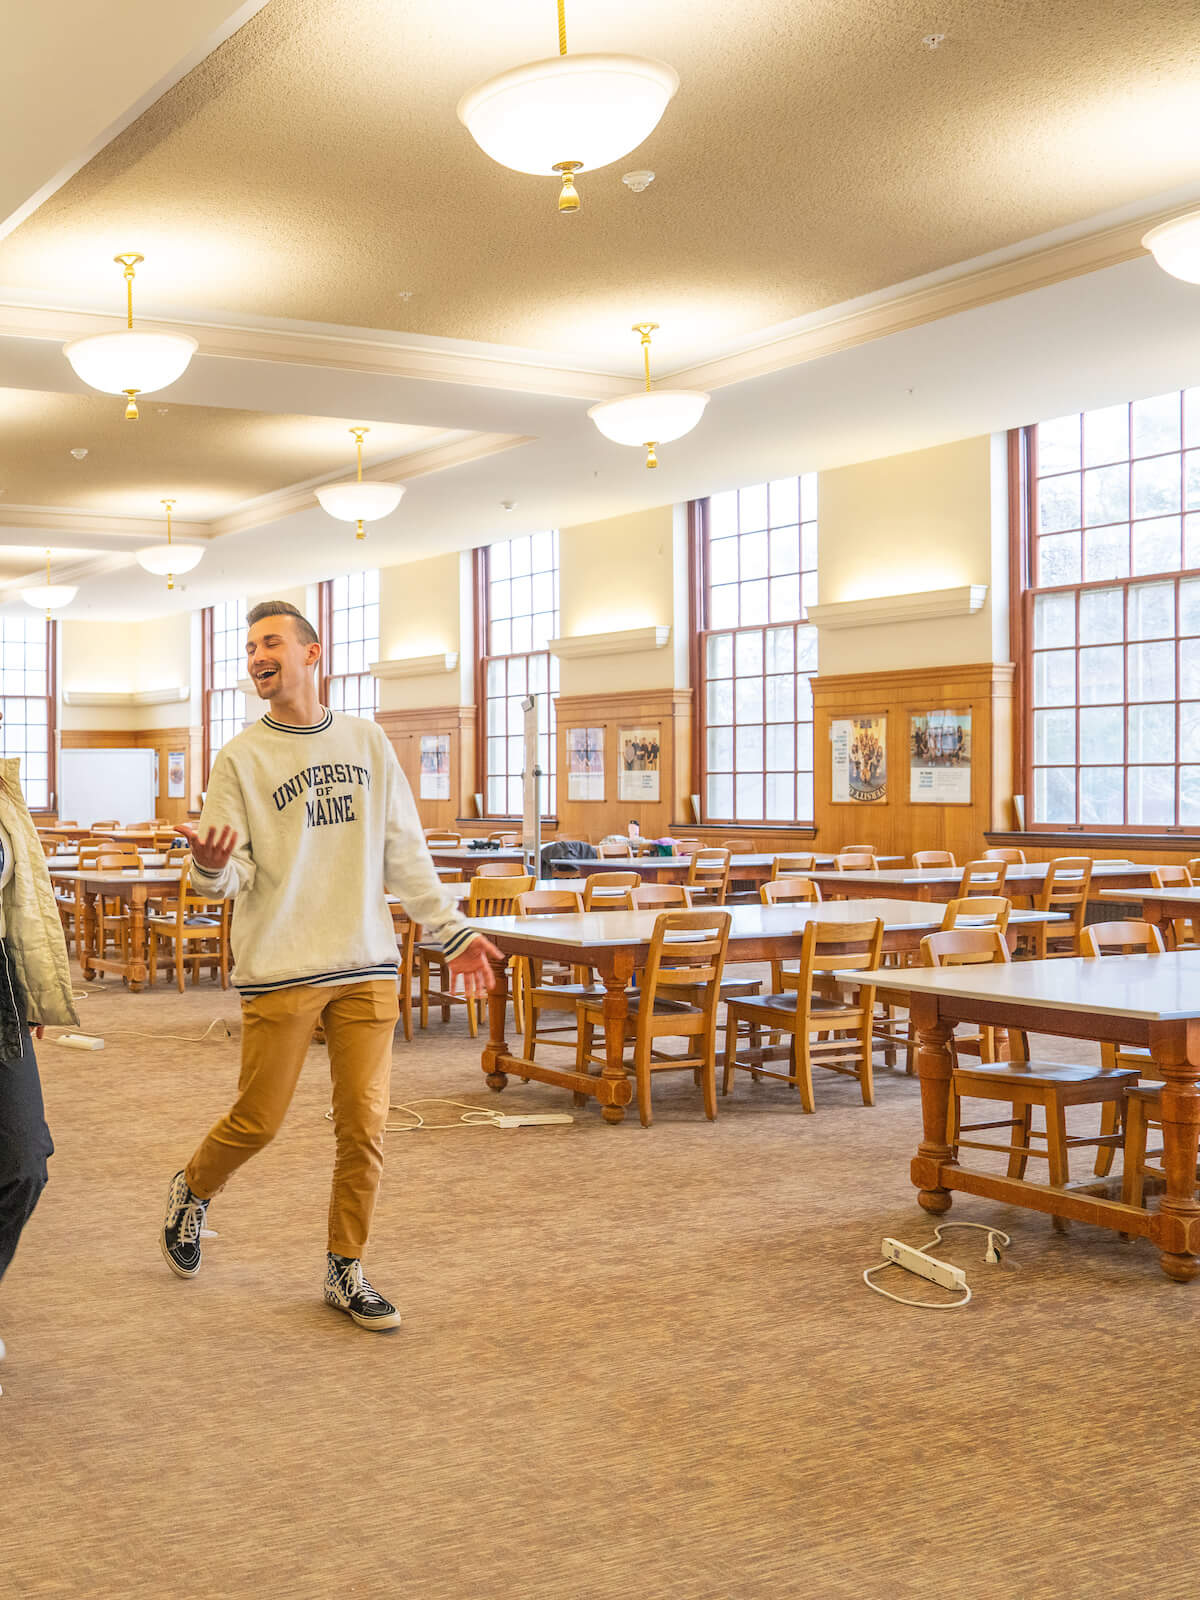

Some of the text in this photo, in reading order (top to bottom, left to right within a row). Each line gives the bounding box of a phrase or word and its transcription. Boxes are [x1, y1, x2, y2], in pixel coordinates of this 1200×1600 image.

[272, 763, 372, 812] UNIVERSITY
[316, 786, 334, 797] OF
[306, 795, 356, 828] MAINE
